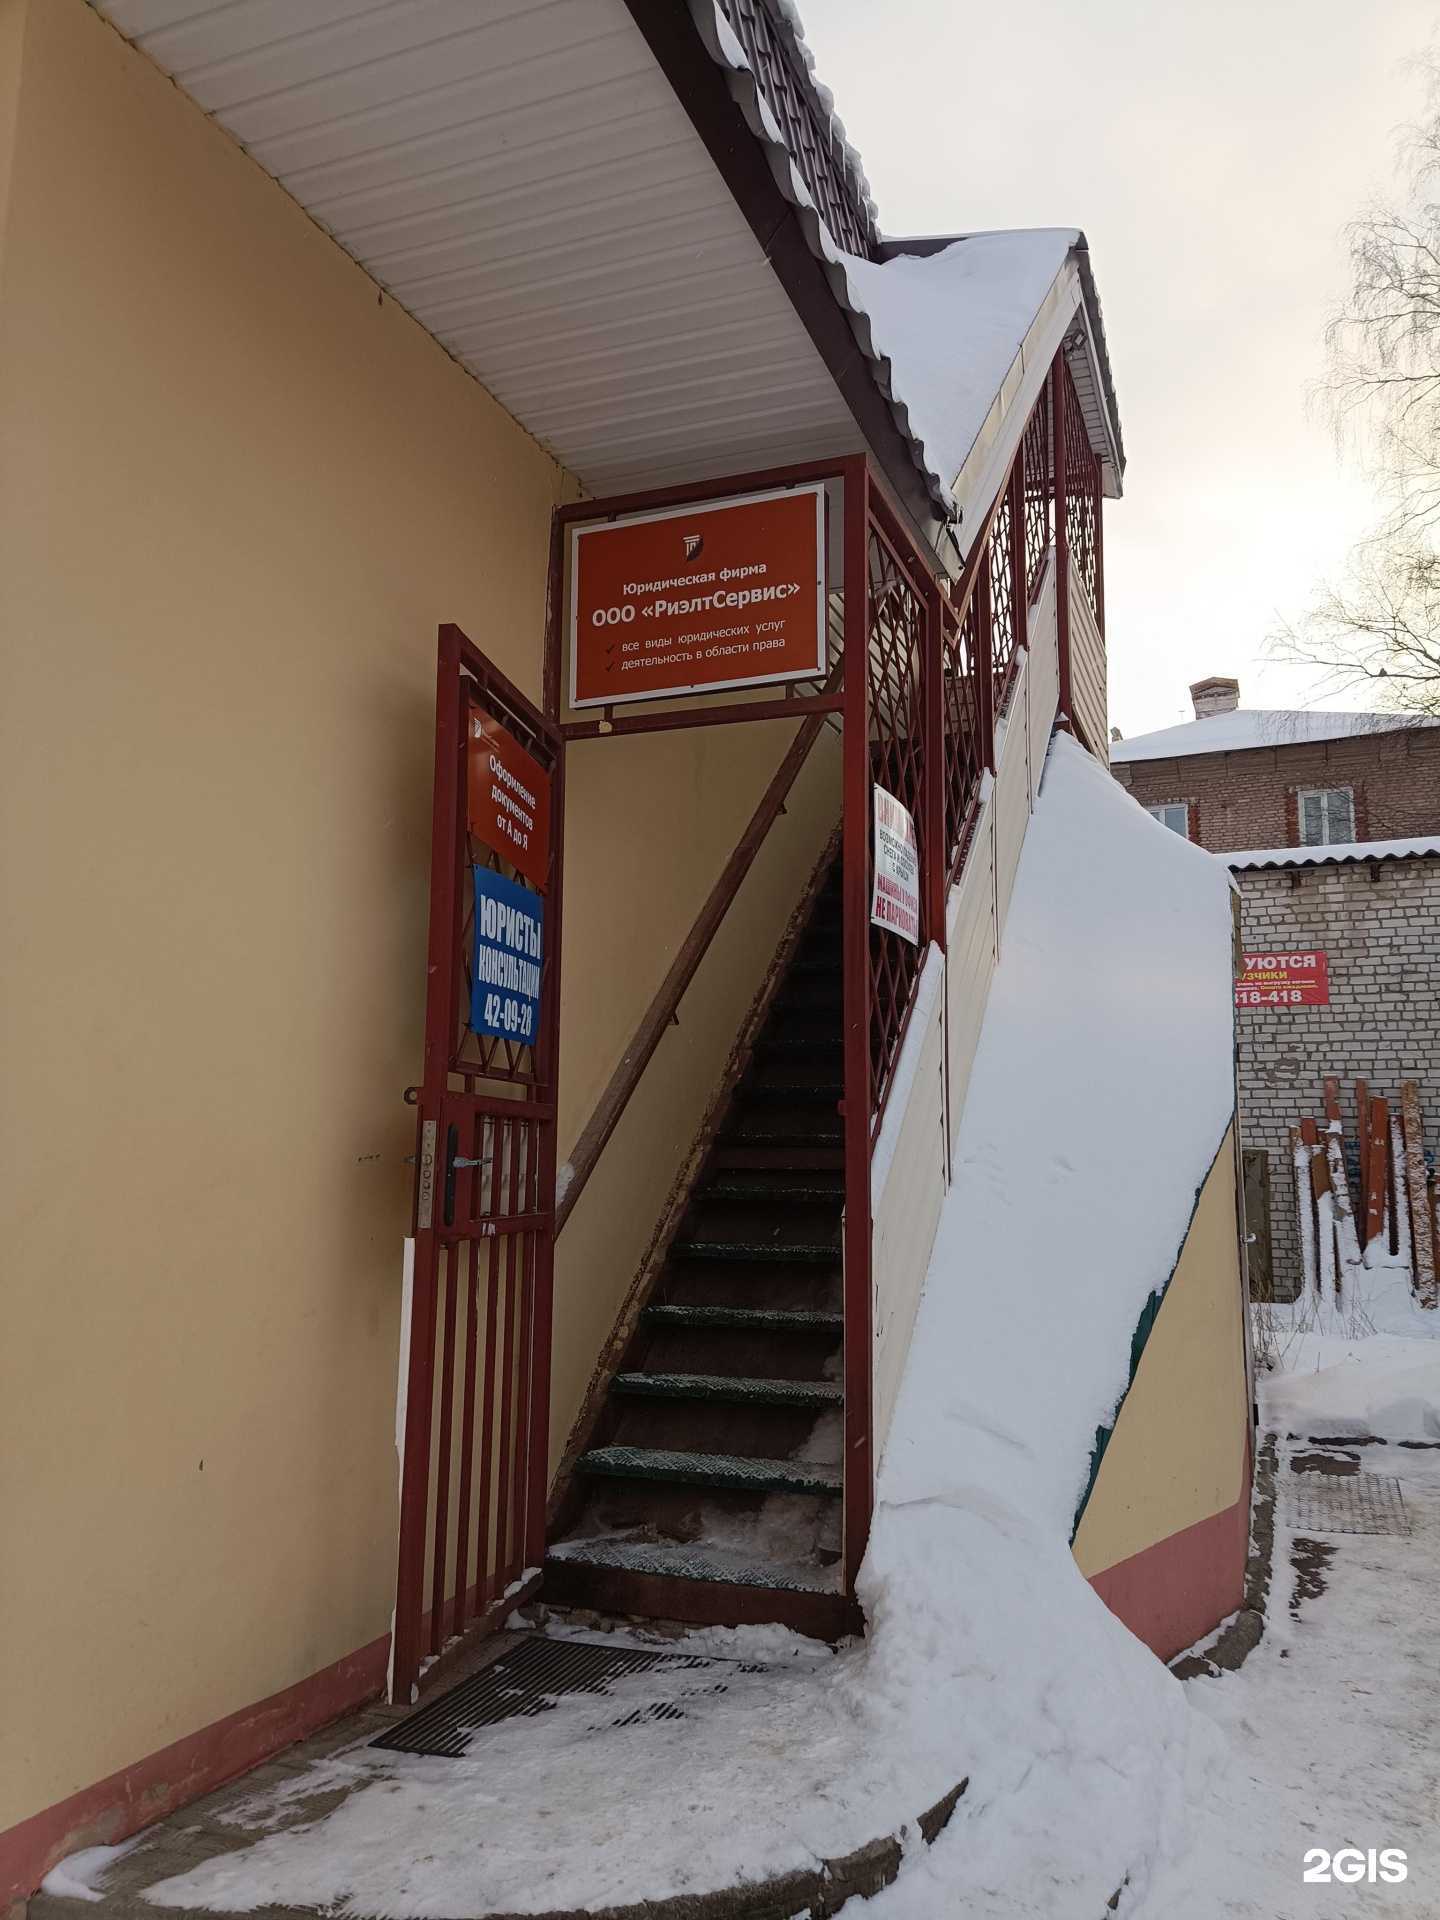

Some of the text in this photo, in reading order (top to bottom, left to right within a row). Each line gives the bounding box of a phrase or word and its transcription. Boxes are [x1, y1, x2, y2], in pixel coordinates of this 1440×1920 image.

[623, 562, 767, 596] Юридическая фирма
[592, 583, 801, 627] ООО «РиэлтСервис»
[621, 638, 785, 671] деятельность в области права
[622, 618, 785, 652] все виды юридических услуг
[489, 754, 536, 810] Оформление
[491, 784, 533, 831] документов
[497, 814, 528, 851] от А до Я
[480, 894, 541, 960] ЮРИСТЫ
[875, 895, 886, 919] НЕ
[478, 944, 541, 1001] КОНСУЛЬТАЦИИ
[484, 993, 532, 1036] 42-09-28
